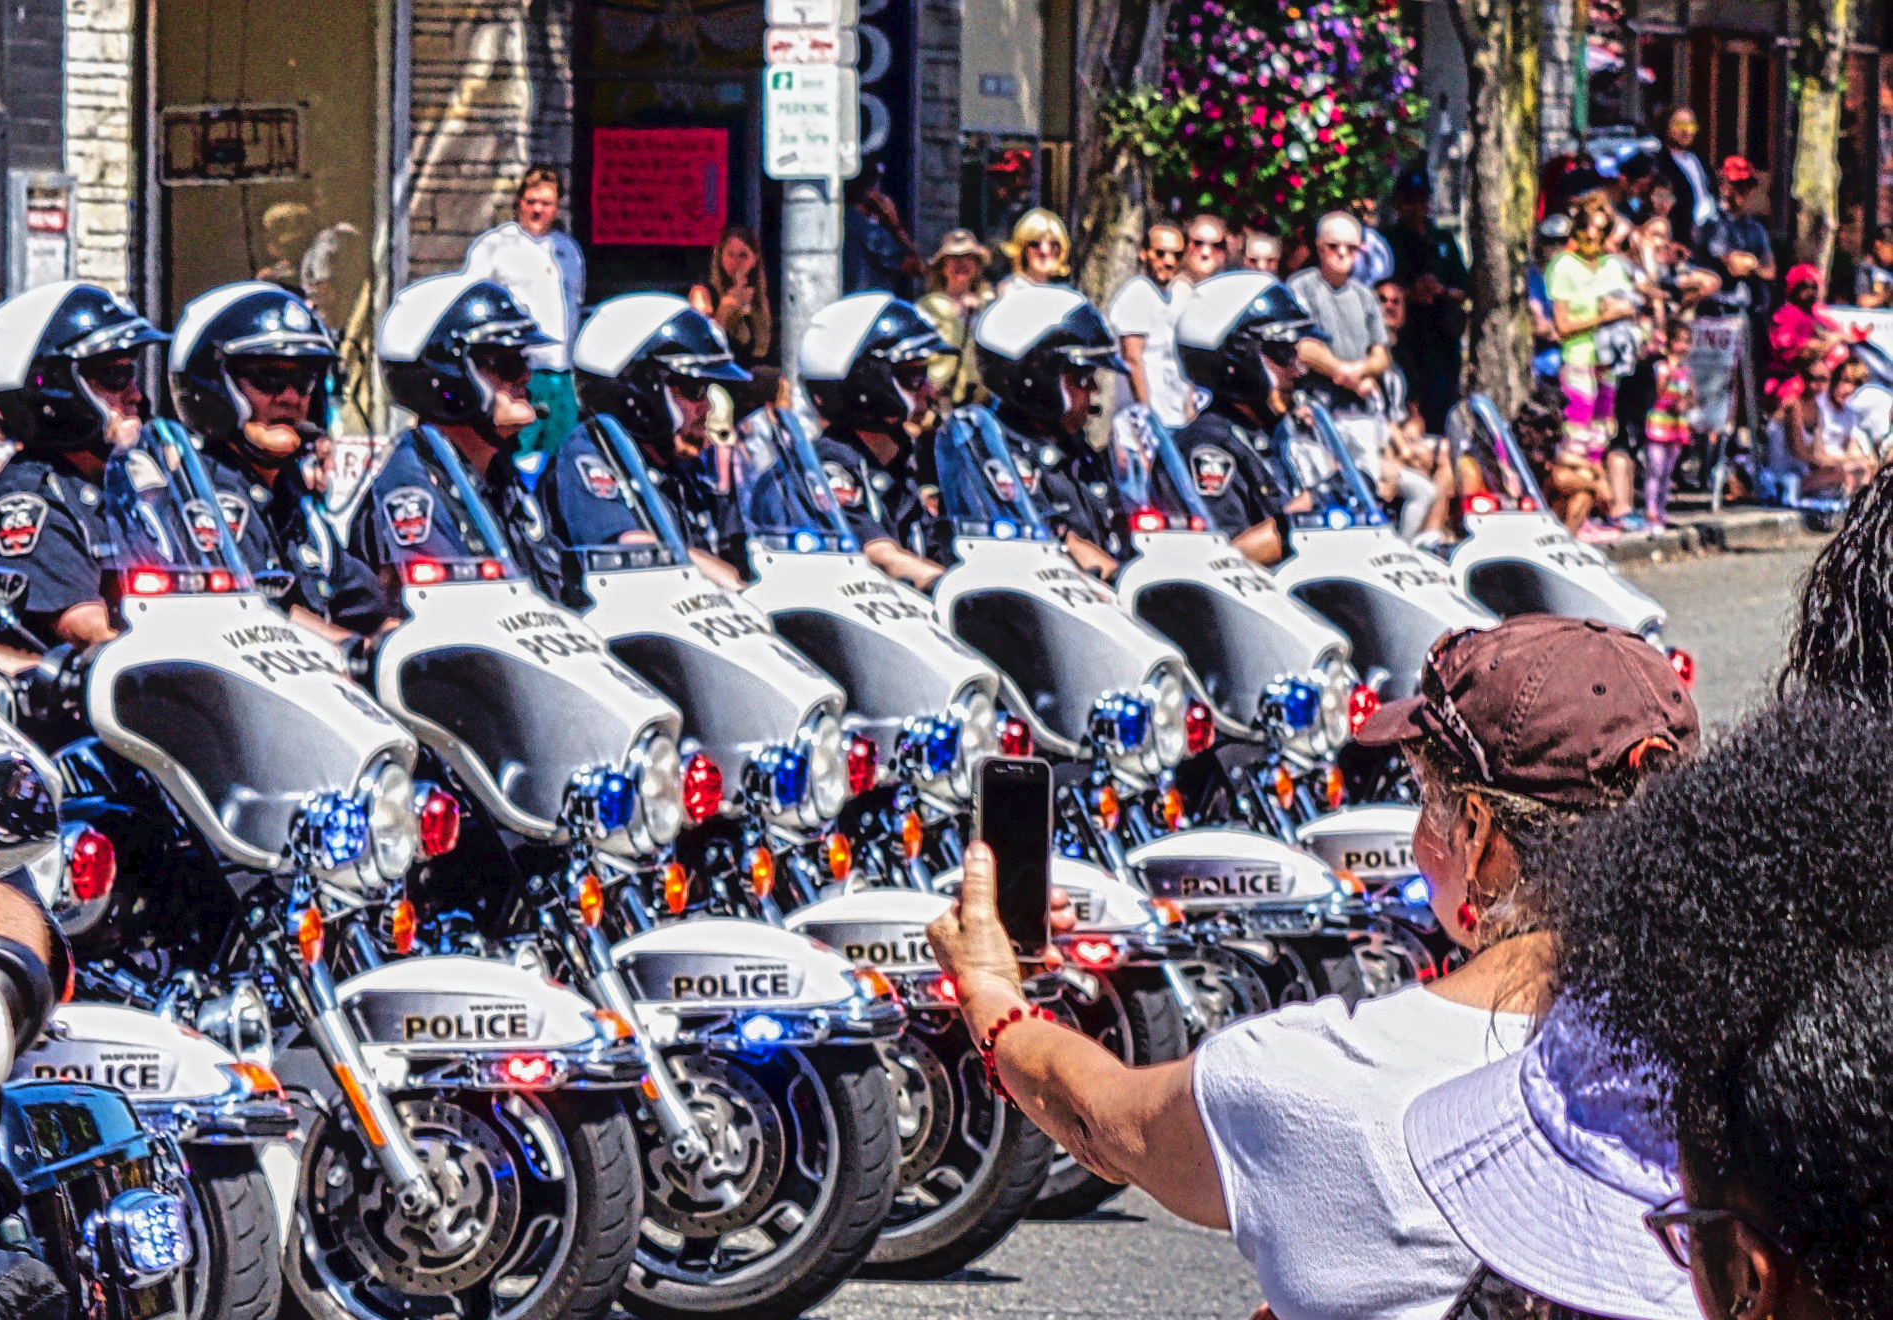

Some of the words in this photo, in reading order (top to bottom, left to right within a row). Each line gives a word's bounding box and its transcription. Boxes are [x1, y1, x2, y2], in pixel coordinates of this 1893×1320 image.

[1182, 874, 1281, 896] POLICE
[673, 972, 790, 999] POLICE
[404, 1012, 528, 1041] POLICE
